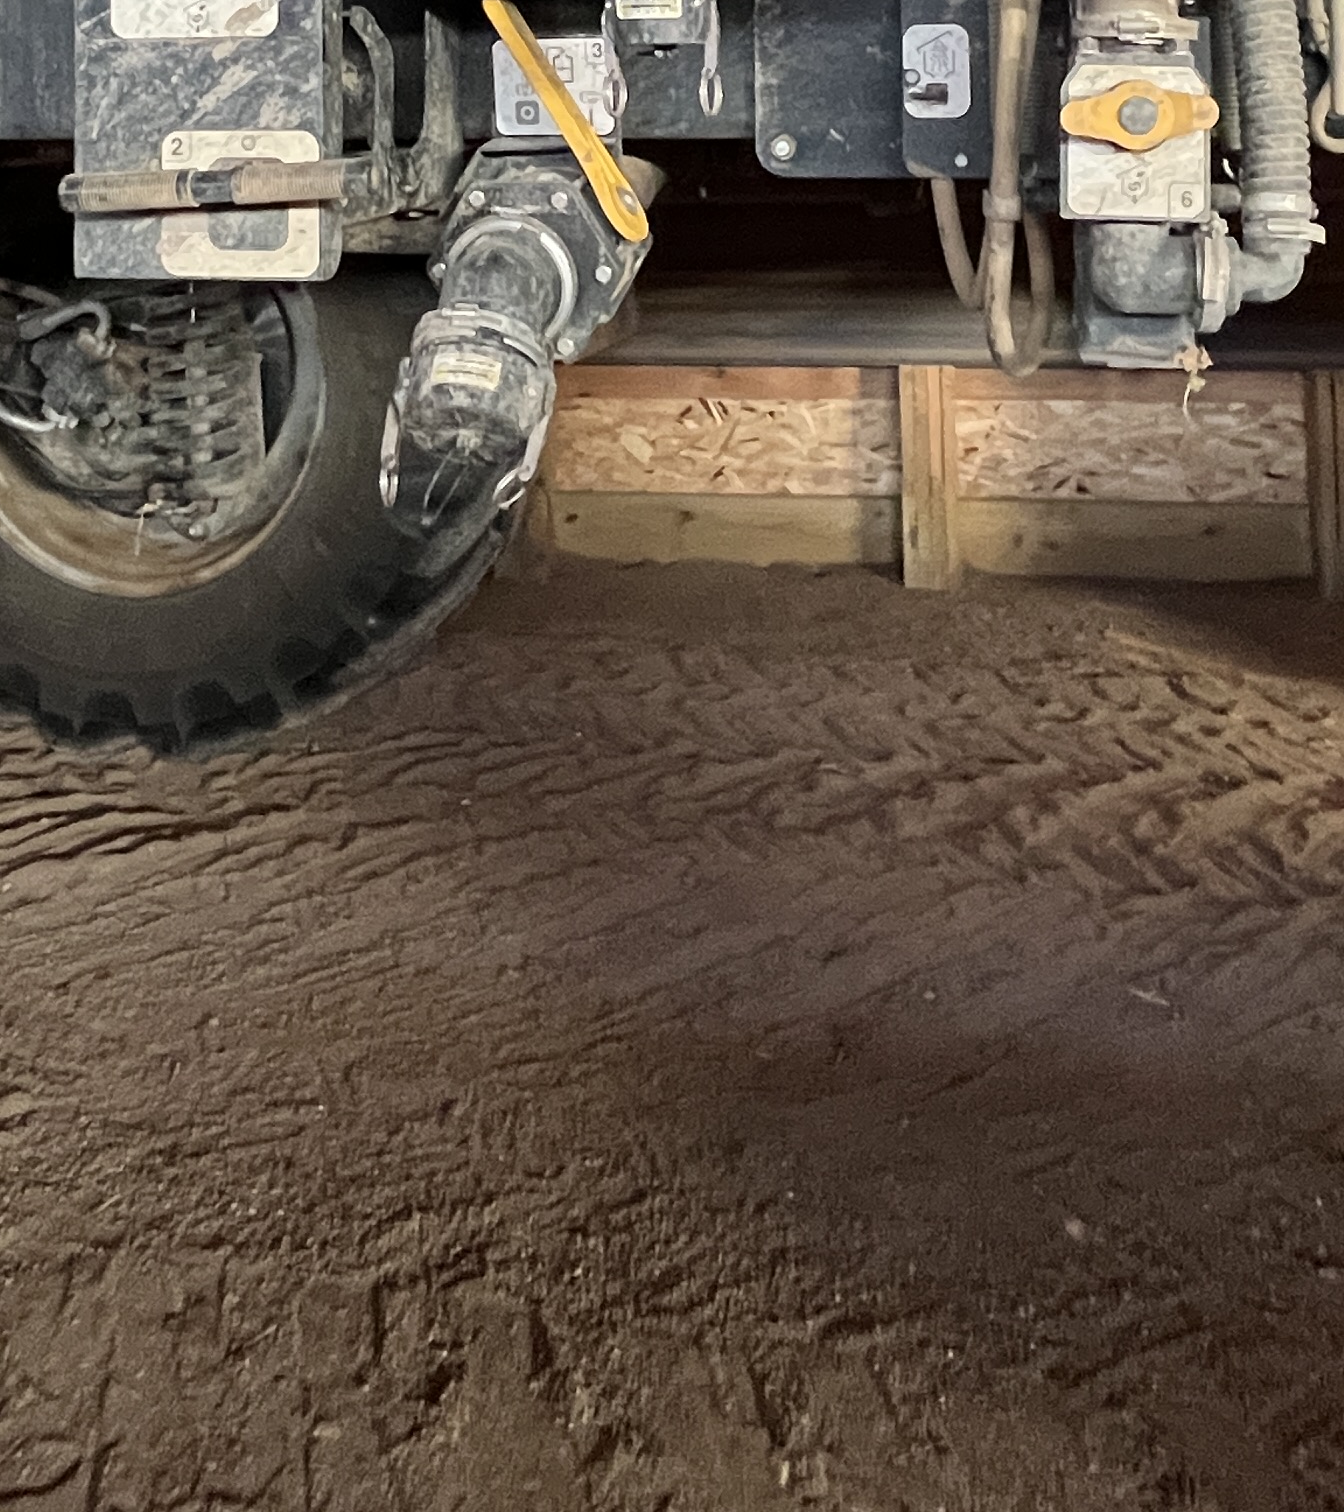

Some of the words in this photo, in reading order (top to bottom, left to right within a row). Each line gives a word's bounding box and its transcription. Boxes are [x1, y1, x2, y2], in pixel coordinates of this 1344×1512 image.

[592, 43, 602, 58] 3
[171, 137, 184, 156] 2
[1181, 190, 1193, 208] 6
